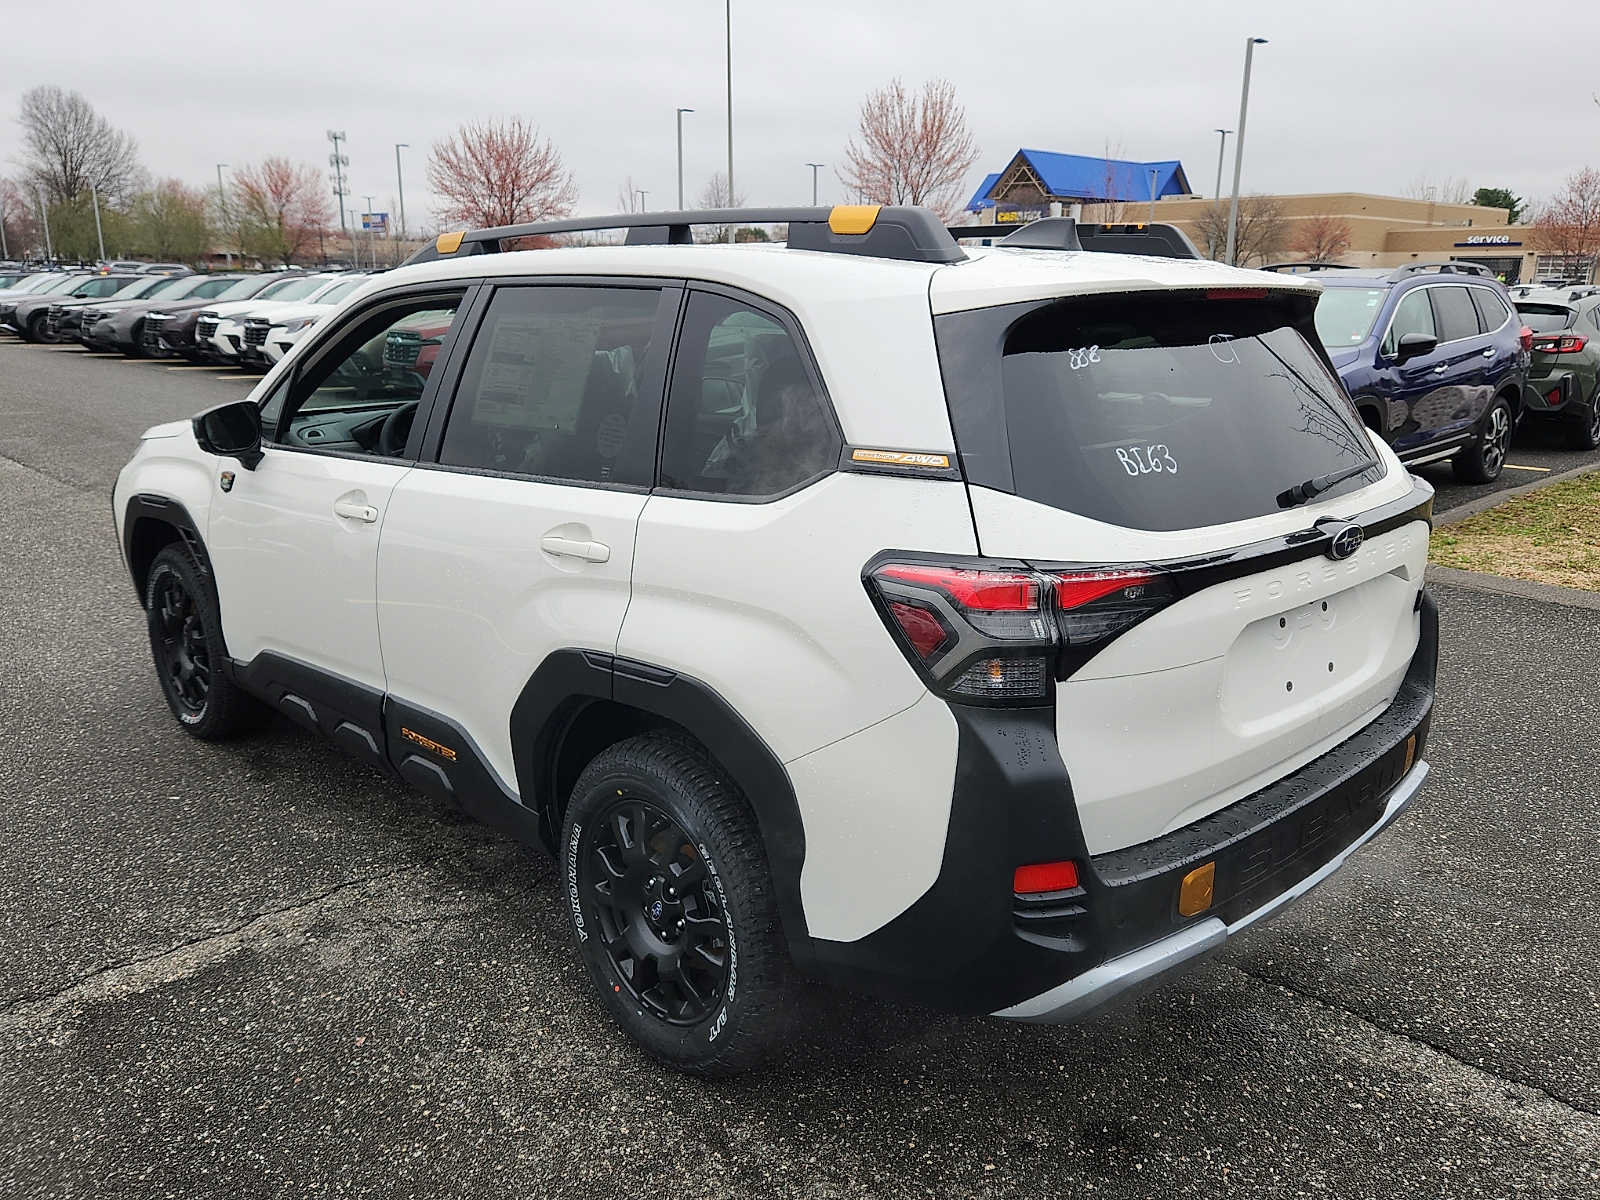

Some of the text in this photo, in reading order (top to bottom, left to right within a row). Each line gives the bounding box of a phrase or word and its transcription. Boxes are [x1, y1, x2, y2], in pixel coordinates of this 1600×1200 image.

[1467, 235, 1510, 243] service
[1068, 344, 1101, 370] 888
[1233, 533, 1415, 610] FORESTER
[401, 727, 457, 761] FORESTER
[567, 823, 588, 943] YOKOHAMA
[698, 842, 737, 1042] GEOLANDAR A/T
